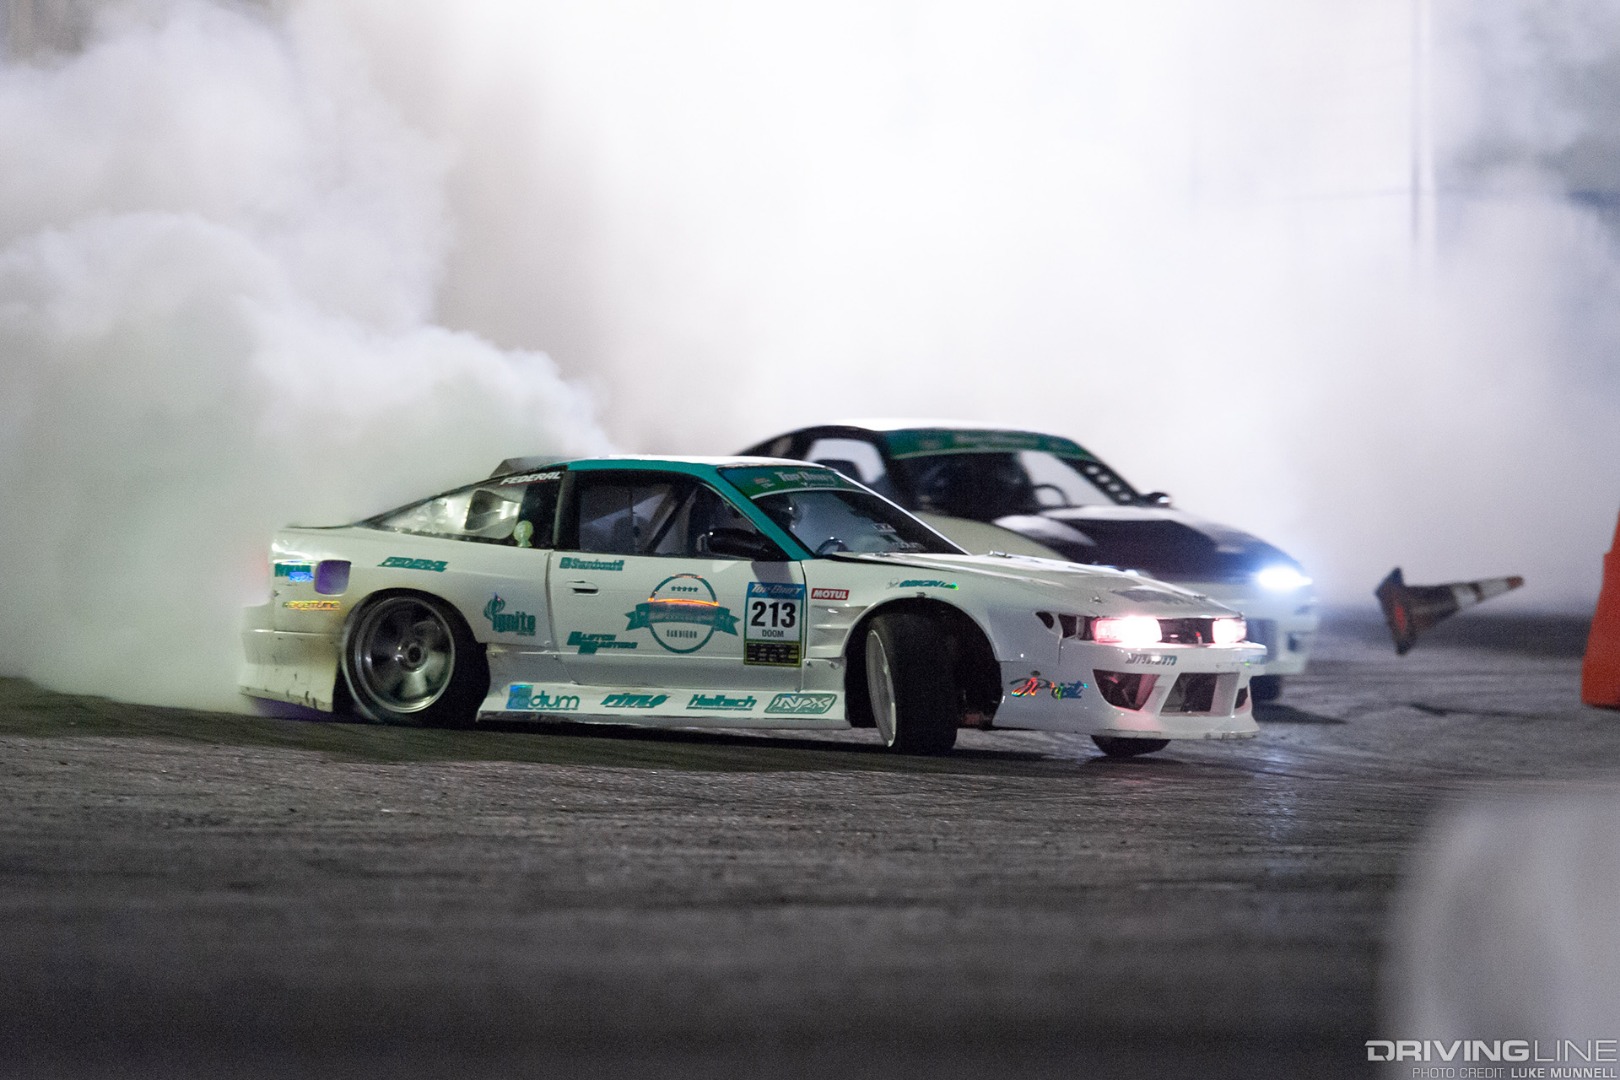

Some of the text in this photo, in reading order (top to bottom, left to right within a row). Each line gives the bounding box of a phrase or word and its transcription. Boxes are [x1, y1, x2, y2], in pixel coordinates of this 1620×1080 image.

[500, 471, 561, 485] FEDERAL
[813, 589, 847, 599] MOTUL
[750, 601, 796, 628] 213
[762, 630, 784, 638] DOOM
